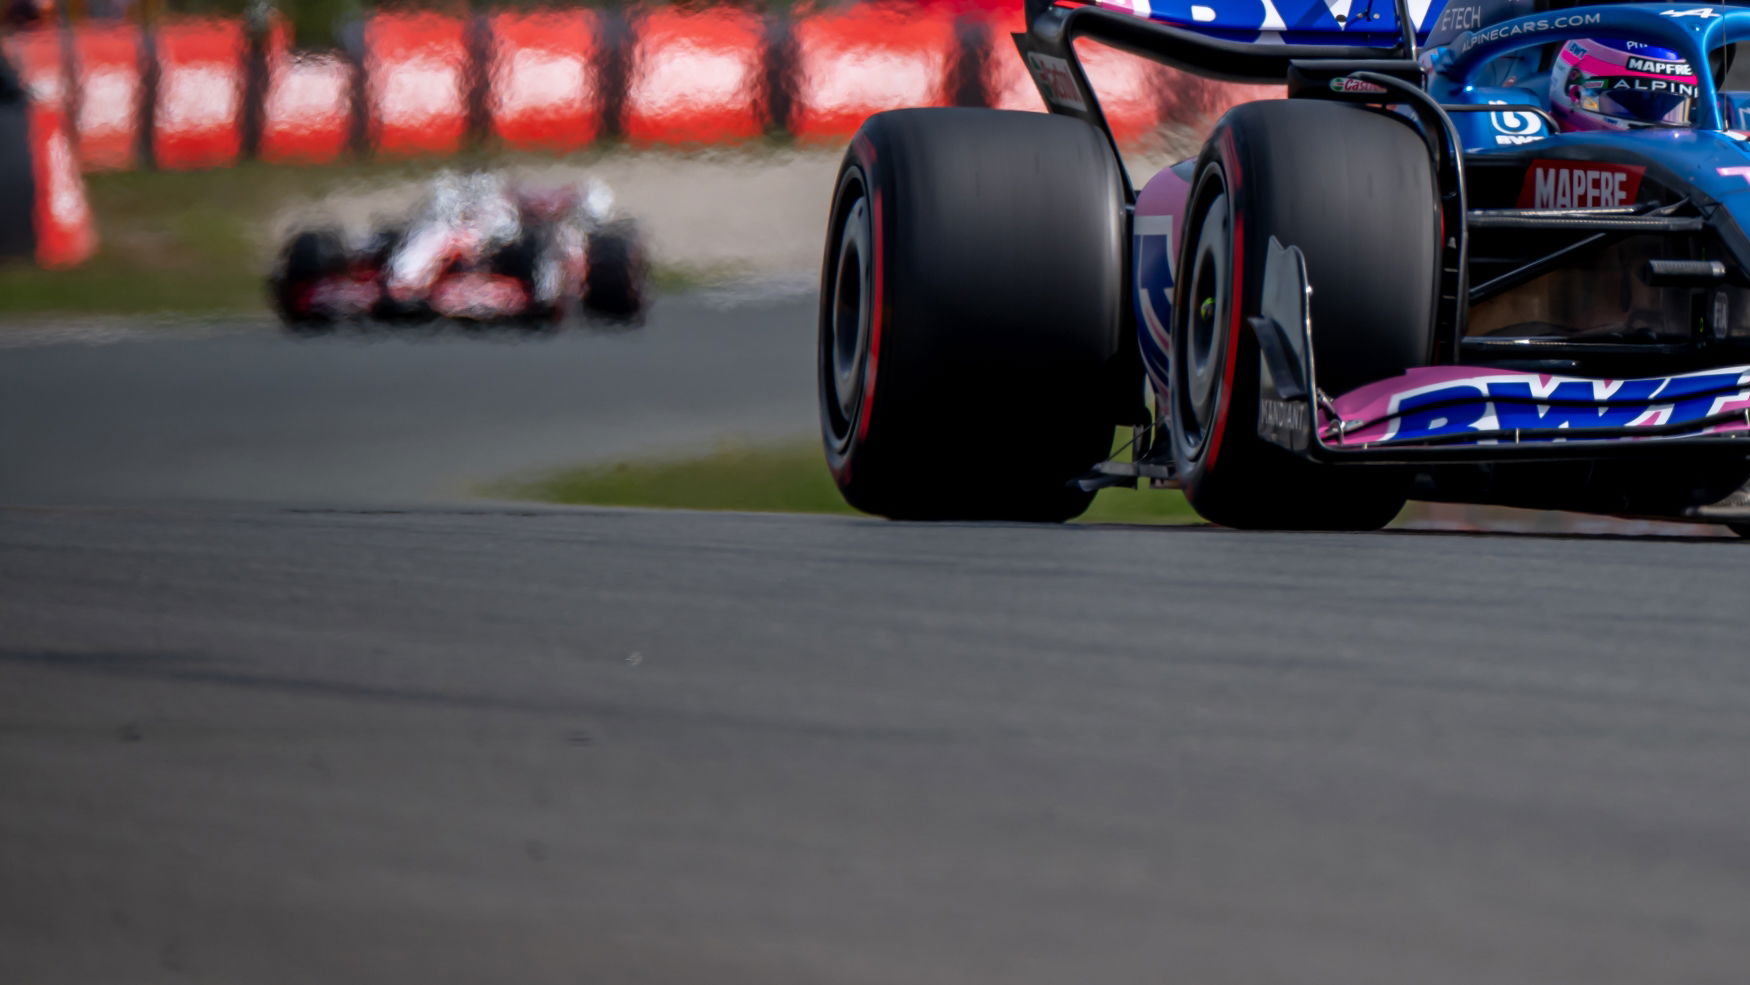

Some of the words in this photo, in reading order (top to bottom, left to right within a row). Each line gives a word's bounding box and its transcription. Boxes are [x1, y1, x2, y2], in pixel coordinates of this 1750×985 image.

[1462, 12, 1601, 52] ALPINECARS.COM
[1628, 58, 1693, 76] MAPFRE
[1535, 167, 1628, 209] MAPFRE
